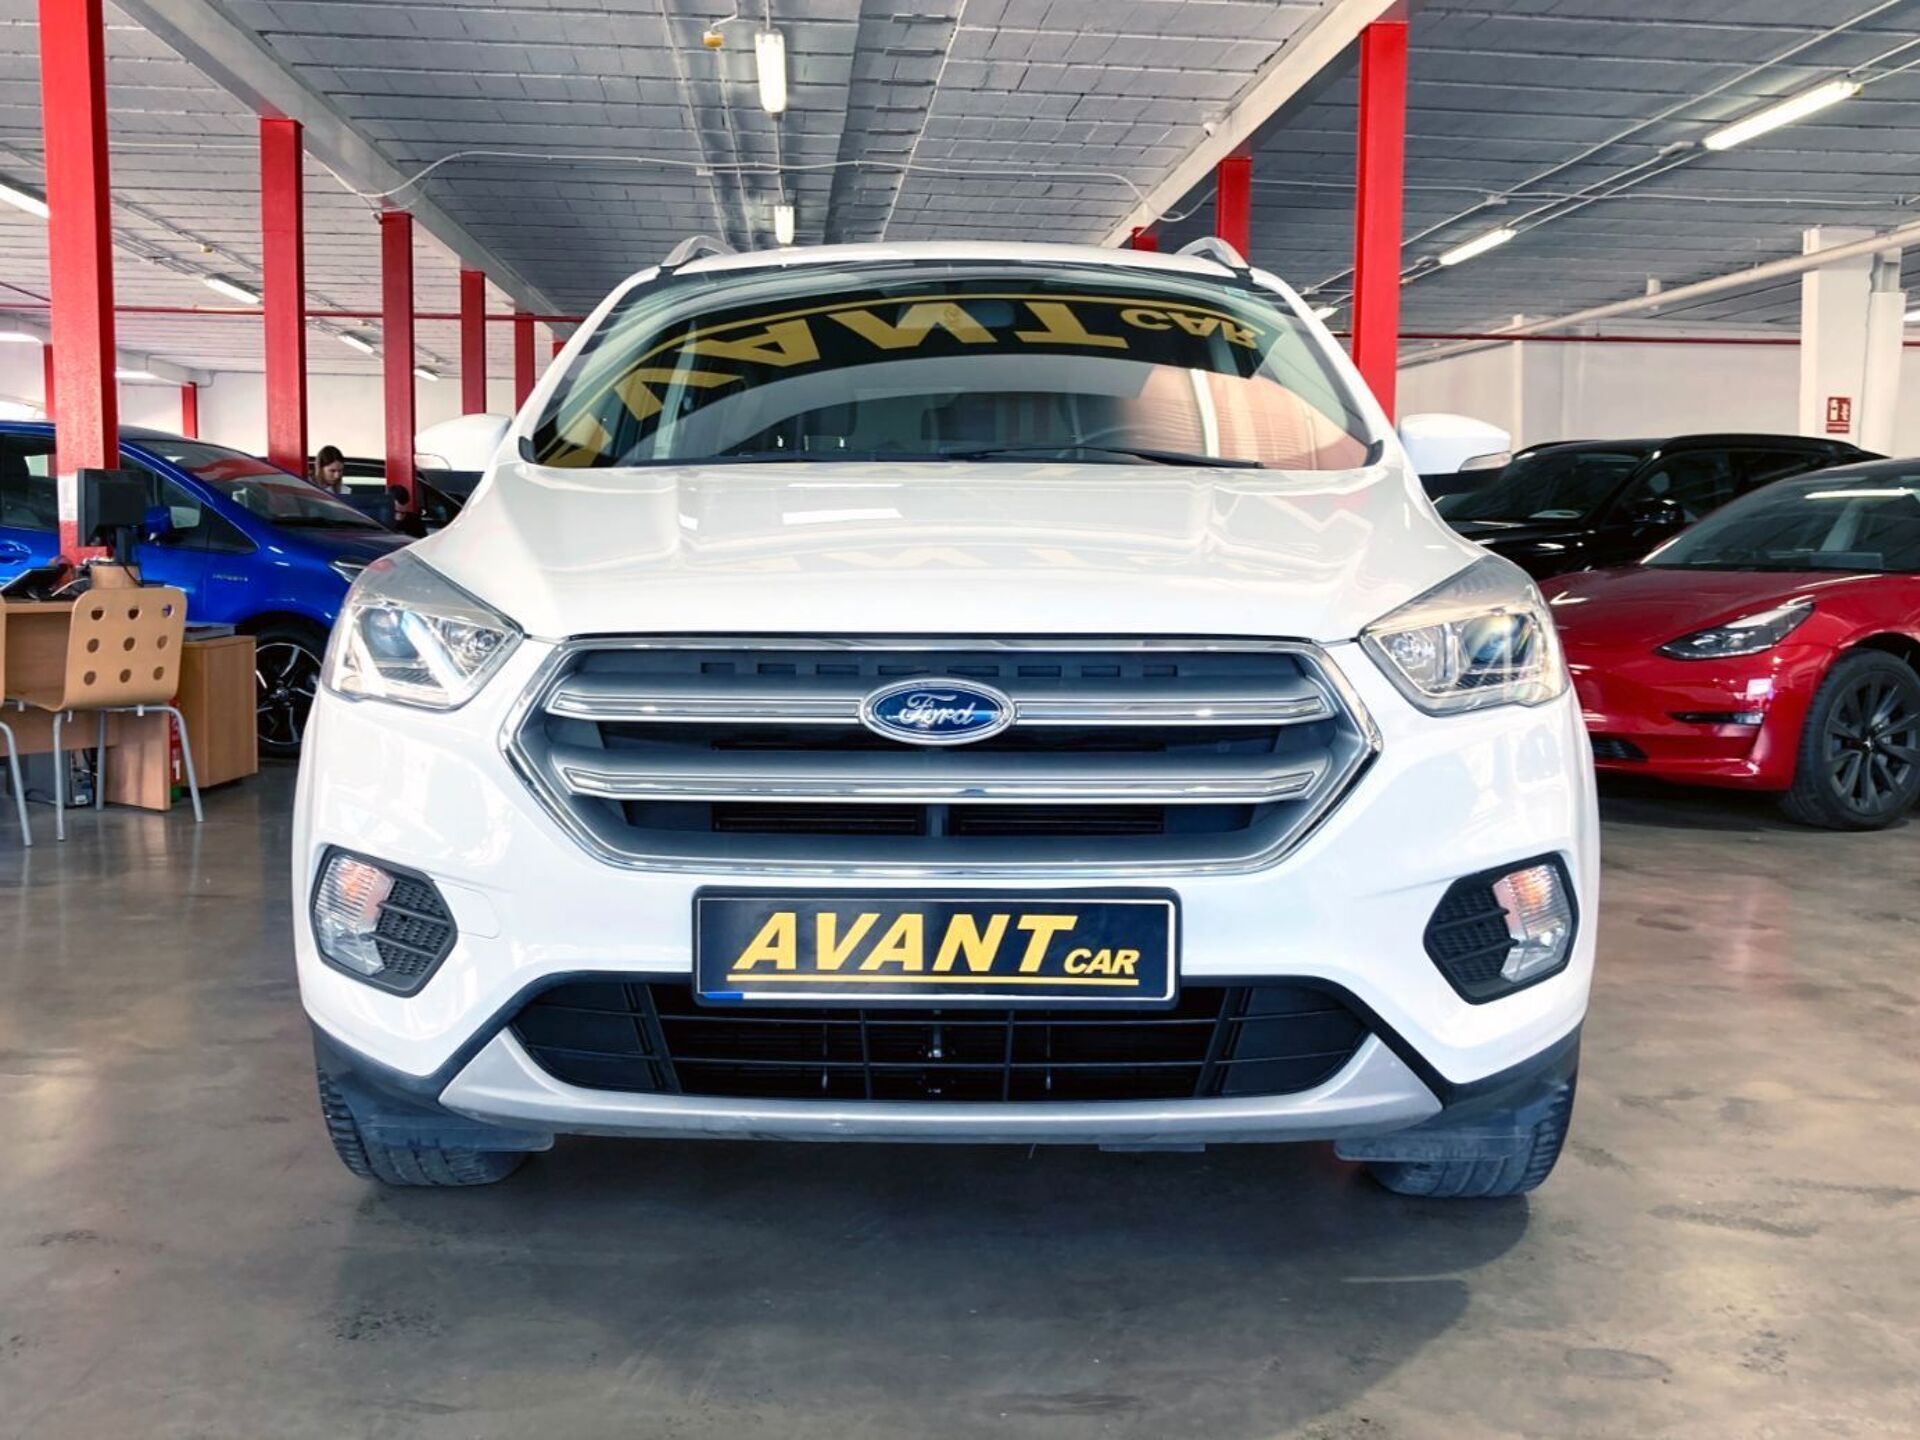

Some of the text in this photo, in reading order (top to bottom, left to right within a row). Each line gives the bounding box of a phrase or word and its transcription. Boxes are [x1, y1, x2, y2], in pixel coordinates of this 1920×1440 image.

[894, 692, 976, 725] Ford
[732, 912, 1140, 975] AVANT CAR
